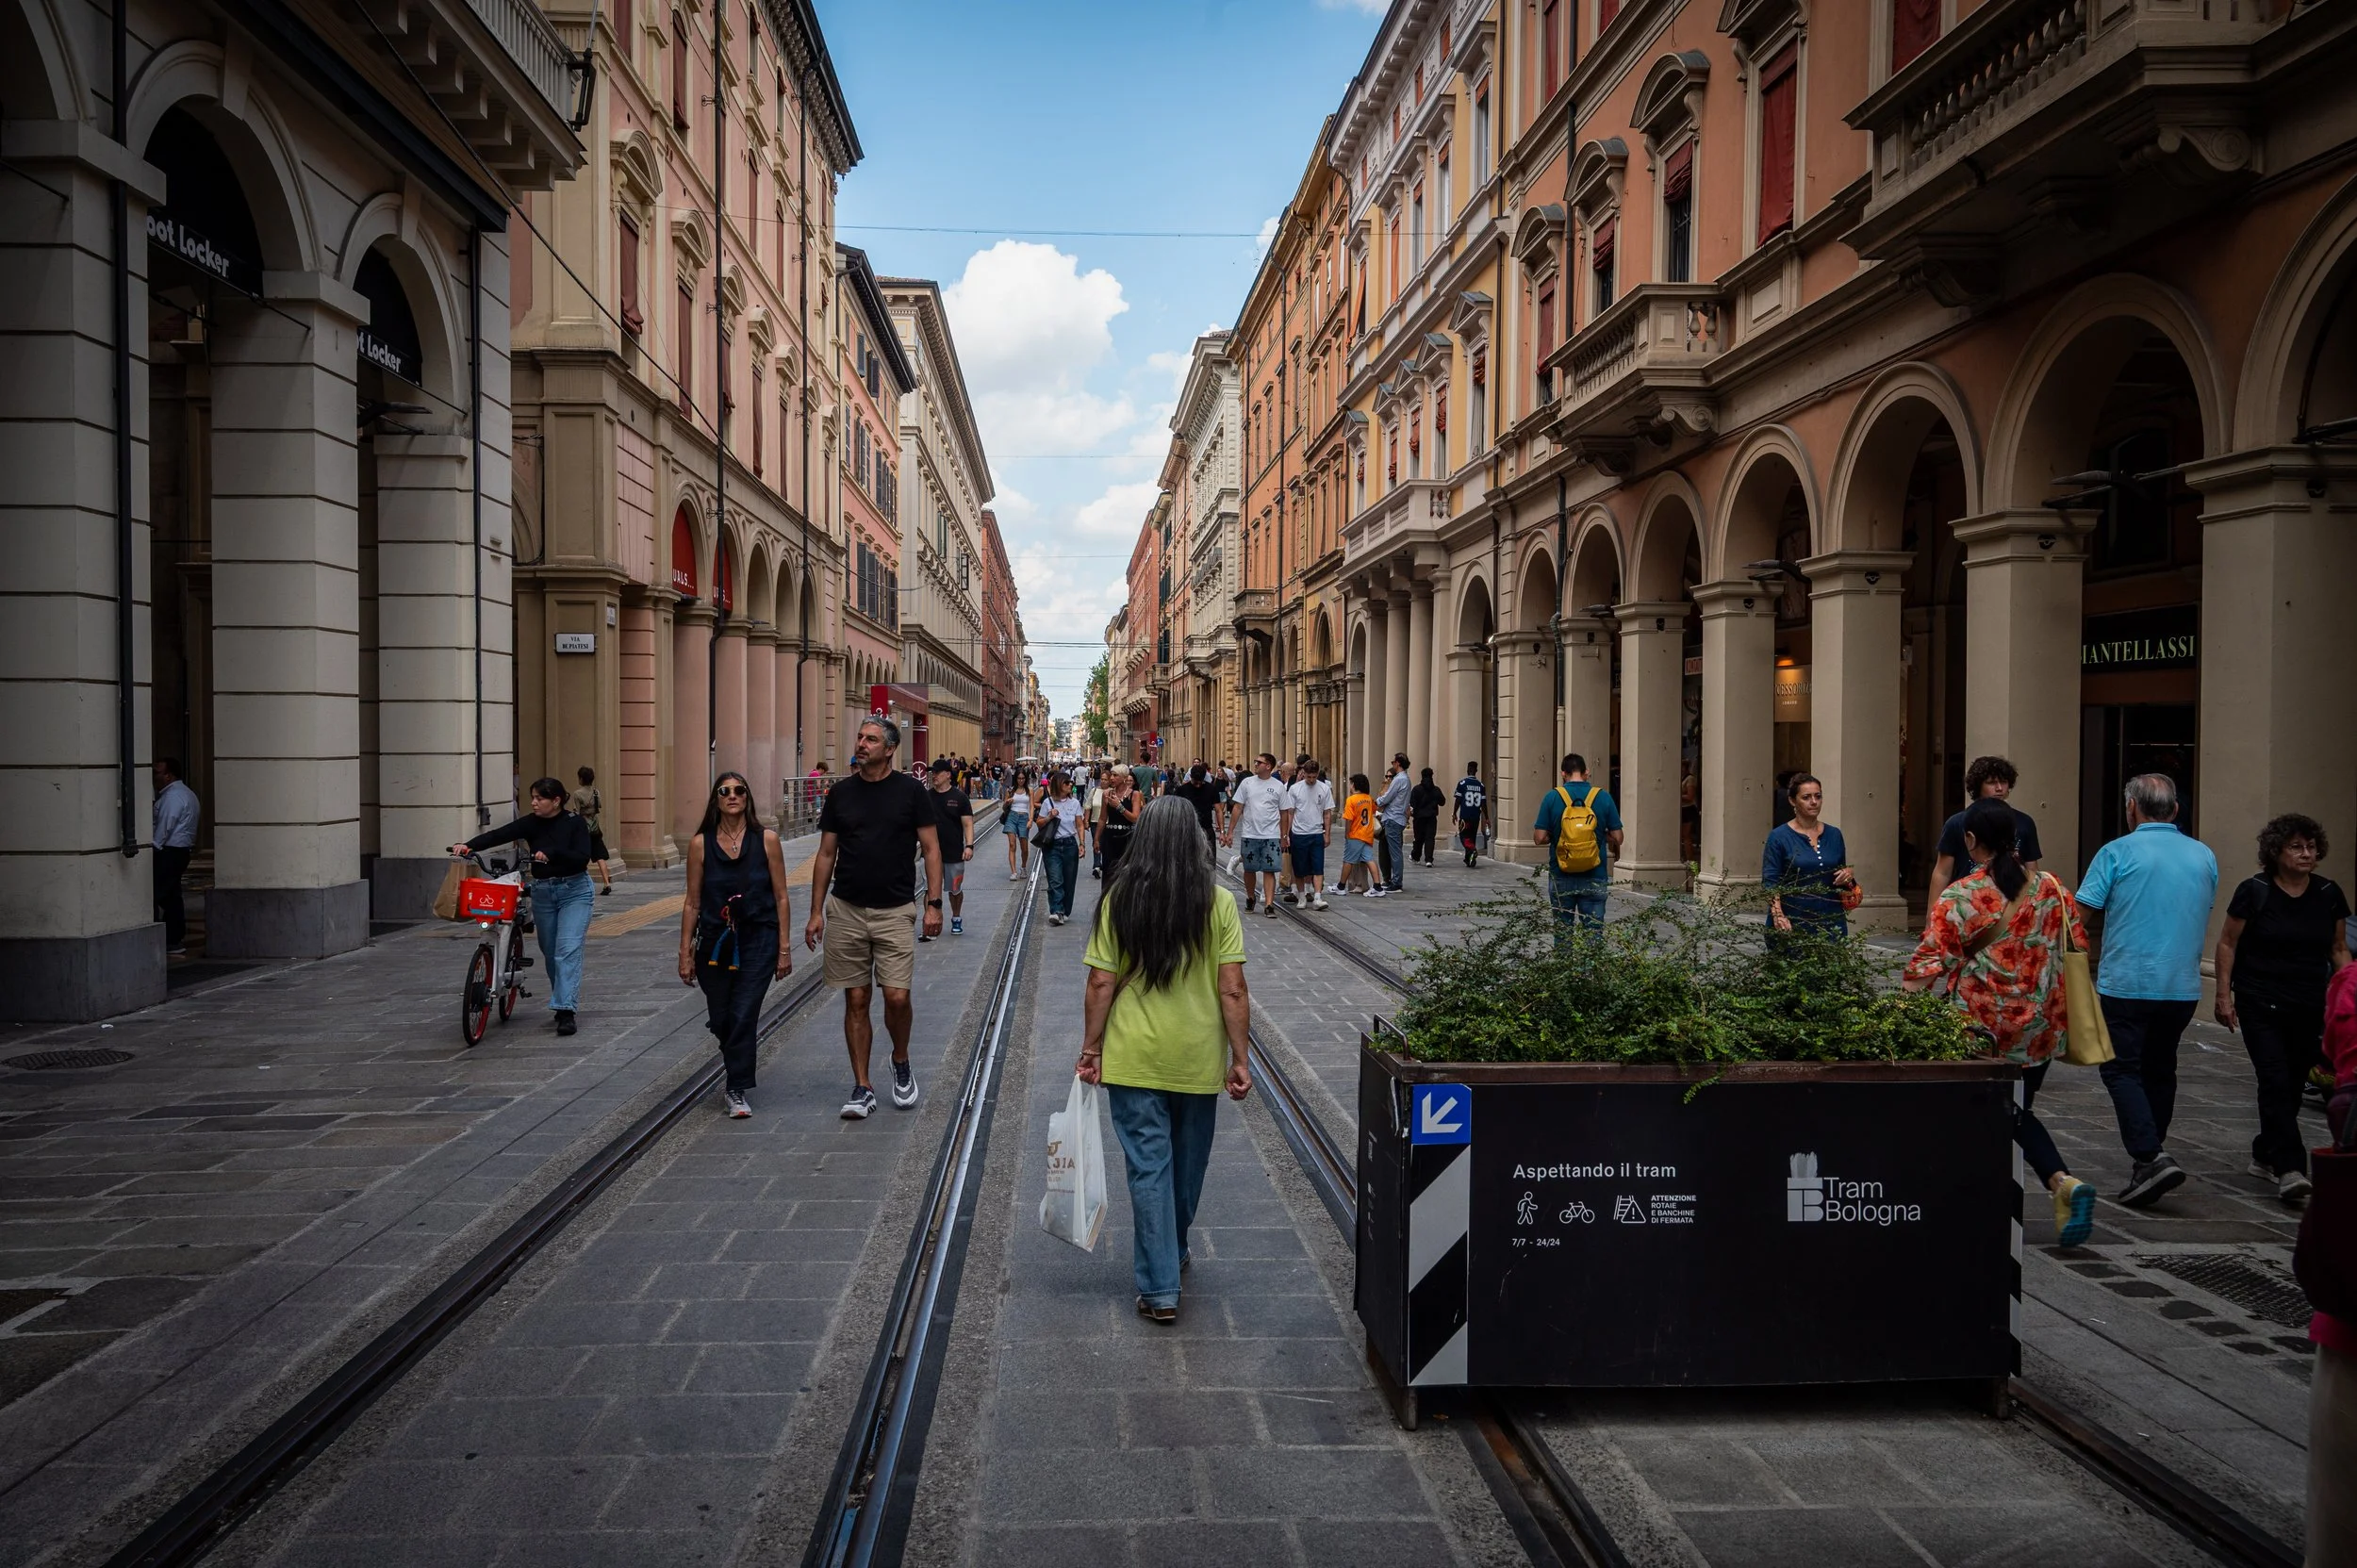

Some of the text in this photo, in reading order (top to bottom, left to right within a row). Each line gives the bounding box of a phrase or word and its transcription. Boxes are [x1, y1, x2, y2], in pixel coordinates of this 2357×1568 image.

[179, 223, 230, 278] Locker
[368, 334, 402, 373] Locker
[1774, 681, 1811, 696] CESSORIZ
[1465, 791, 1482, 807] 93
[1360, 808, 1369, 826] 9
[1512, 1162, 1676, 1182] Aspettando il tram
[1823, 1177, 1884, 1199] Tram
[1825, 1199, 1921, 1227] Bologna
[1511, 1238, 1526, 1247] 7/7
[1536, 1237, 1560, 1247] 24/24
